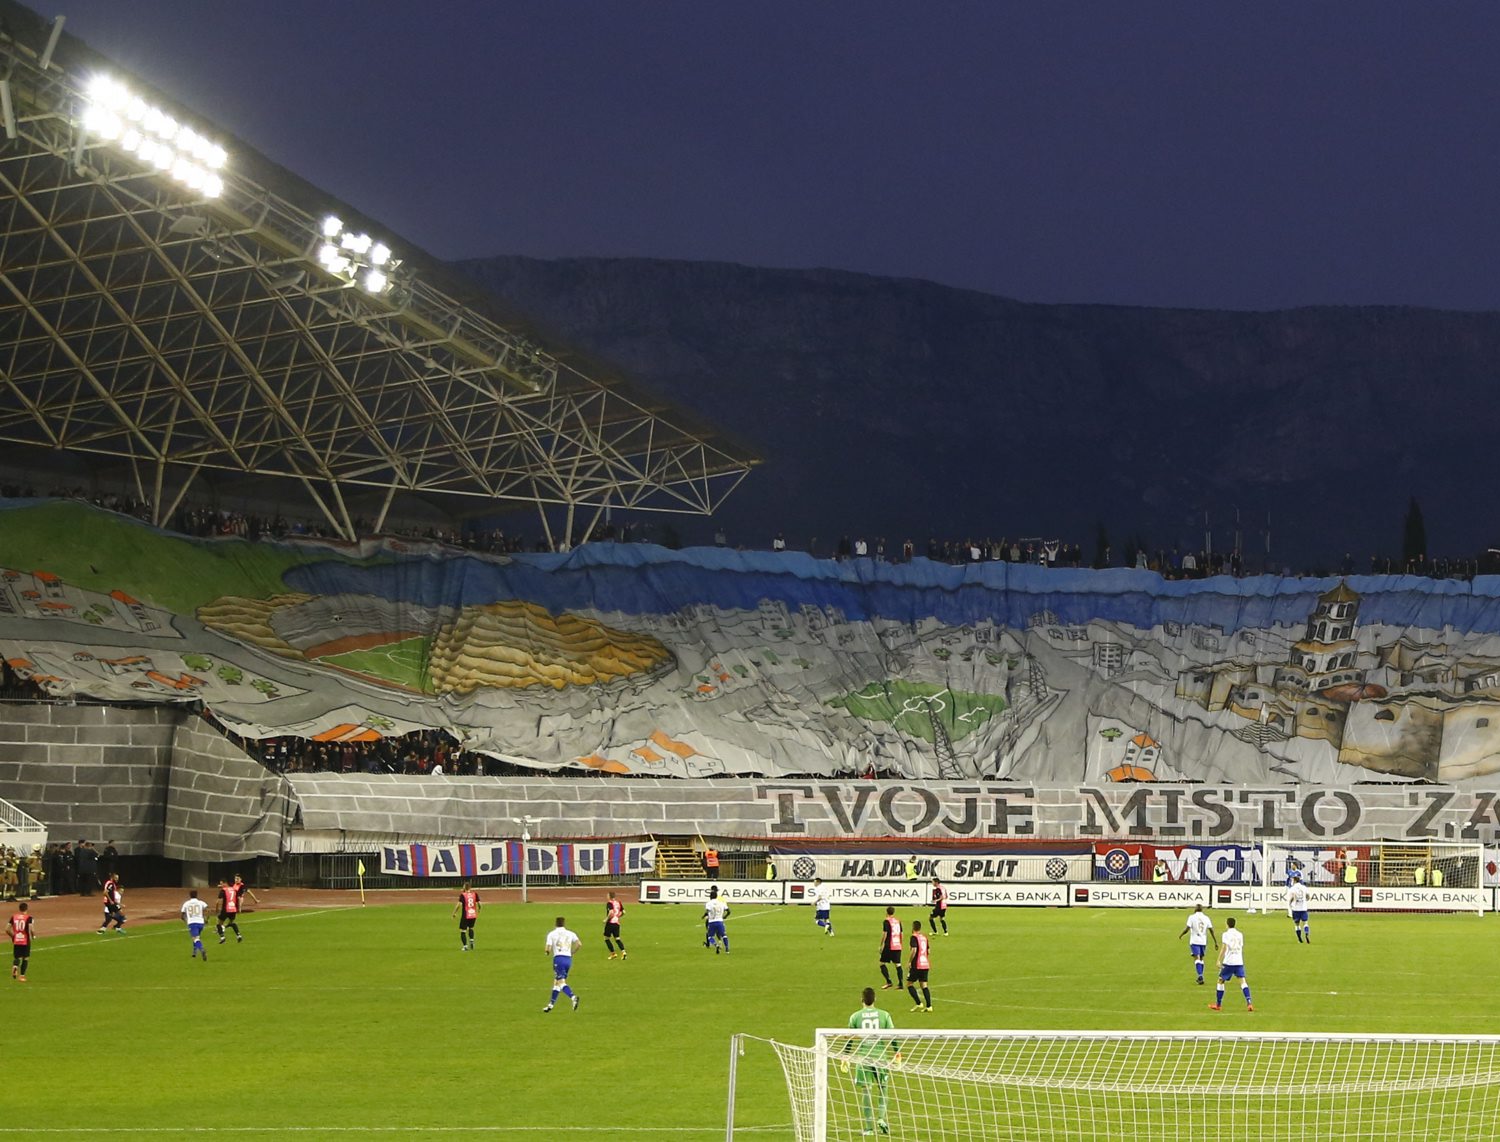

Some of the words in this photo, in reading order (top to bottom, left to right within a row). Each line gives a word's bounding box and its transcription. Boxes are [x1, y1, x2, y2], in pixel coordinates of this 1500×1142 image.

[756, 785, 1034, 835] TVOJE
[1079, 787, 1362, 837] MISTO
[384, 846, 657, 873] HAJDUK
[840, 859, 942, 878] HAJDUK
[953, 859, 1019, 878] SPLIT
[667, 888, 730, 898] SPLITSA
[732, 888, 778, 898] BANKA
[808, 888, 868, 898] SITSKA
[873, 888, 920, 898] BANKA
[949, 891, 1011, 901] SPLITSKA
[1016, 892, 1062, 901] BANKA
[1092, 891, 1154, 901] SPLITSKA
[1159, 892, 1204, 901] BANKA
[1234, 892, 1290, 902] SPLITSK
[1308, 893, 1346, 902] ANKA
[1376, 892, 1438, 902] SPLITSKA
[467, 897, 475, 908] 8
[188, 904, 201, 916] 90
[14, 918, 26, 931] 10
